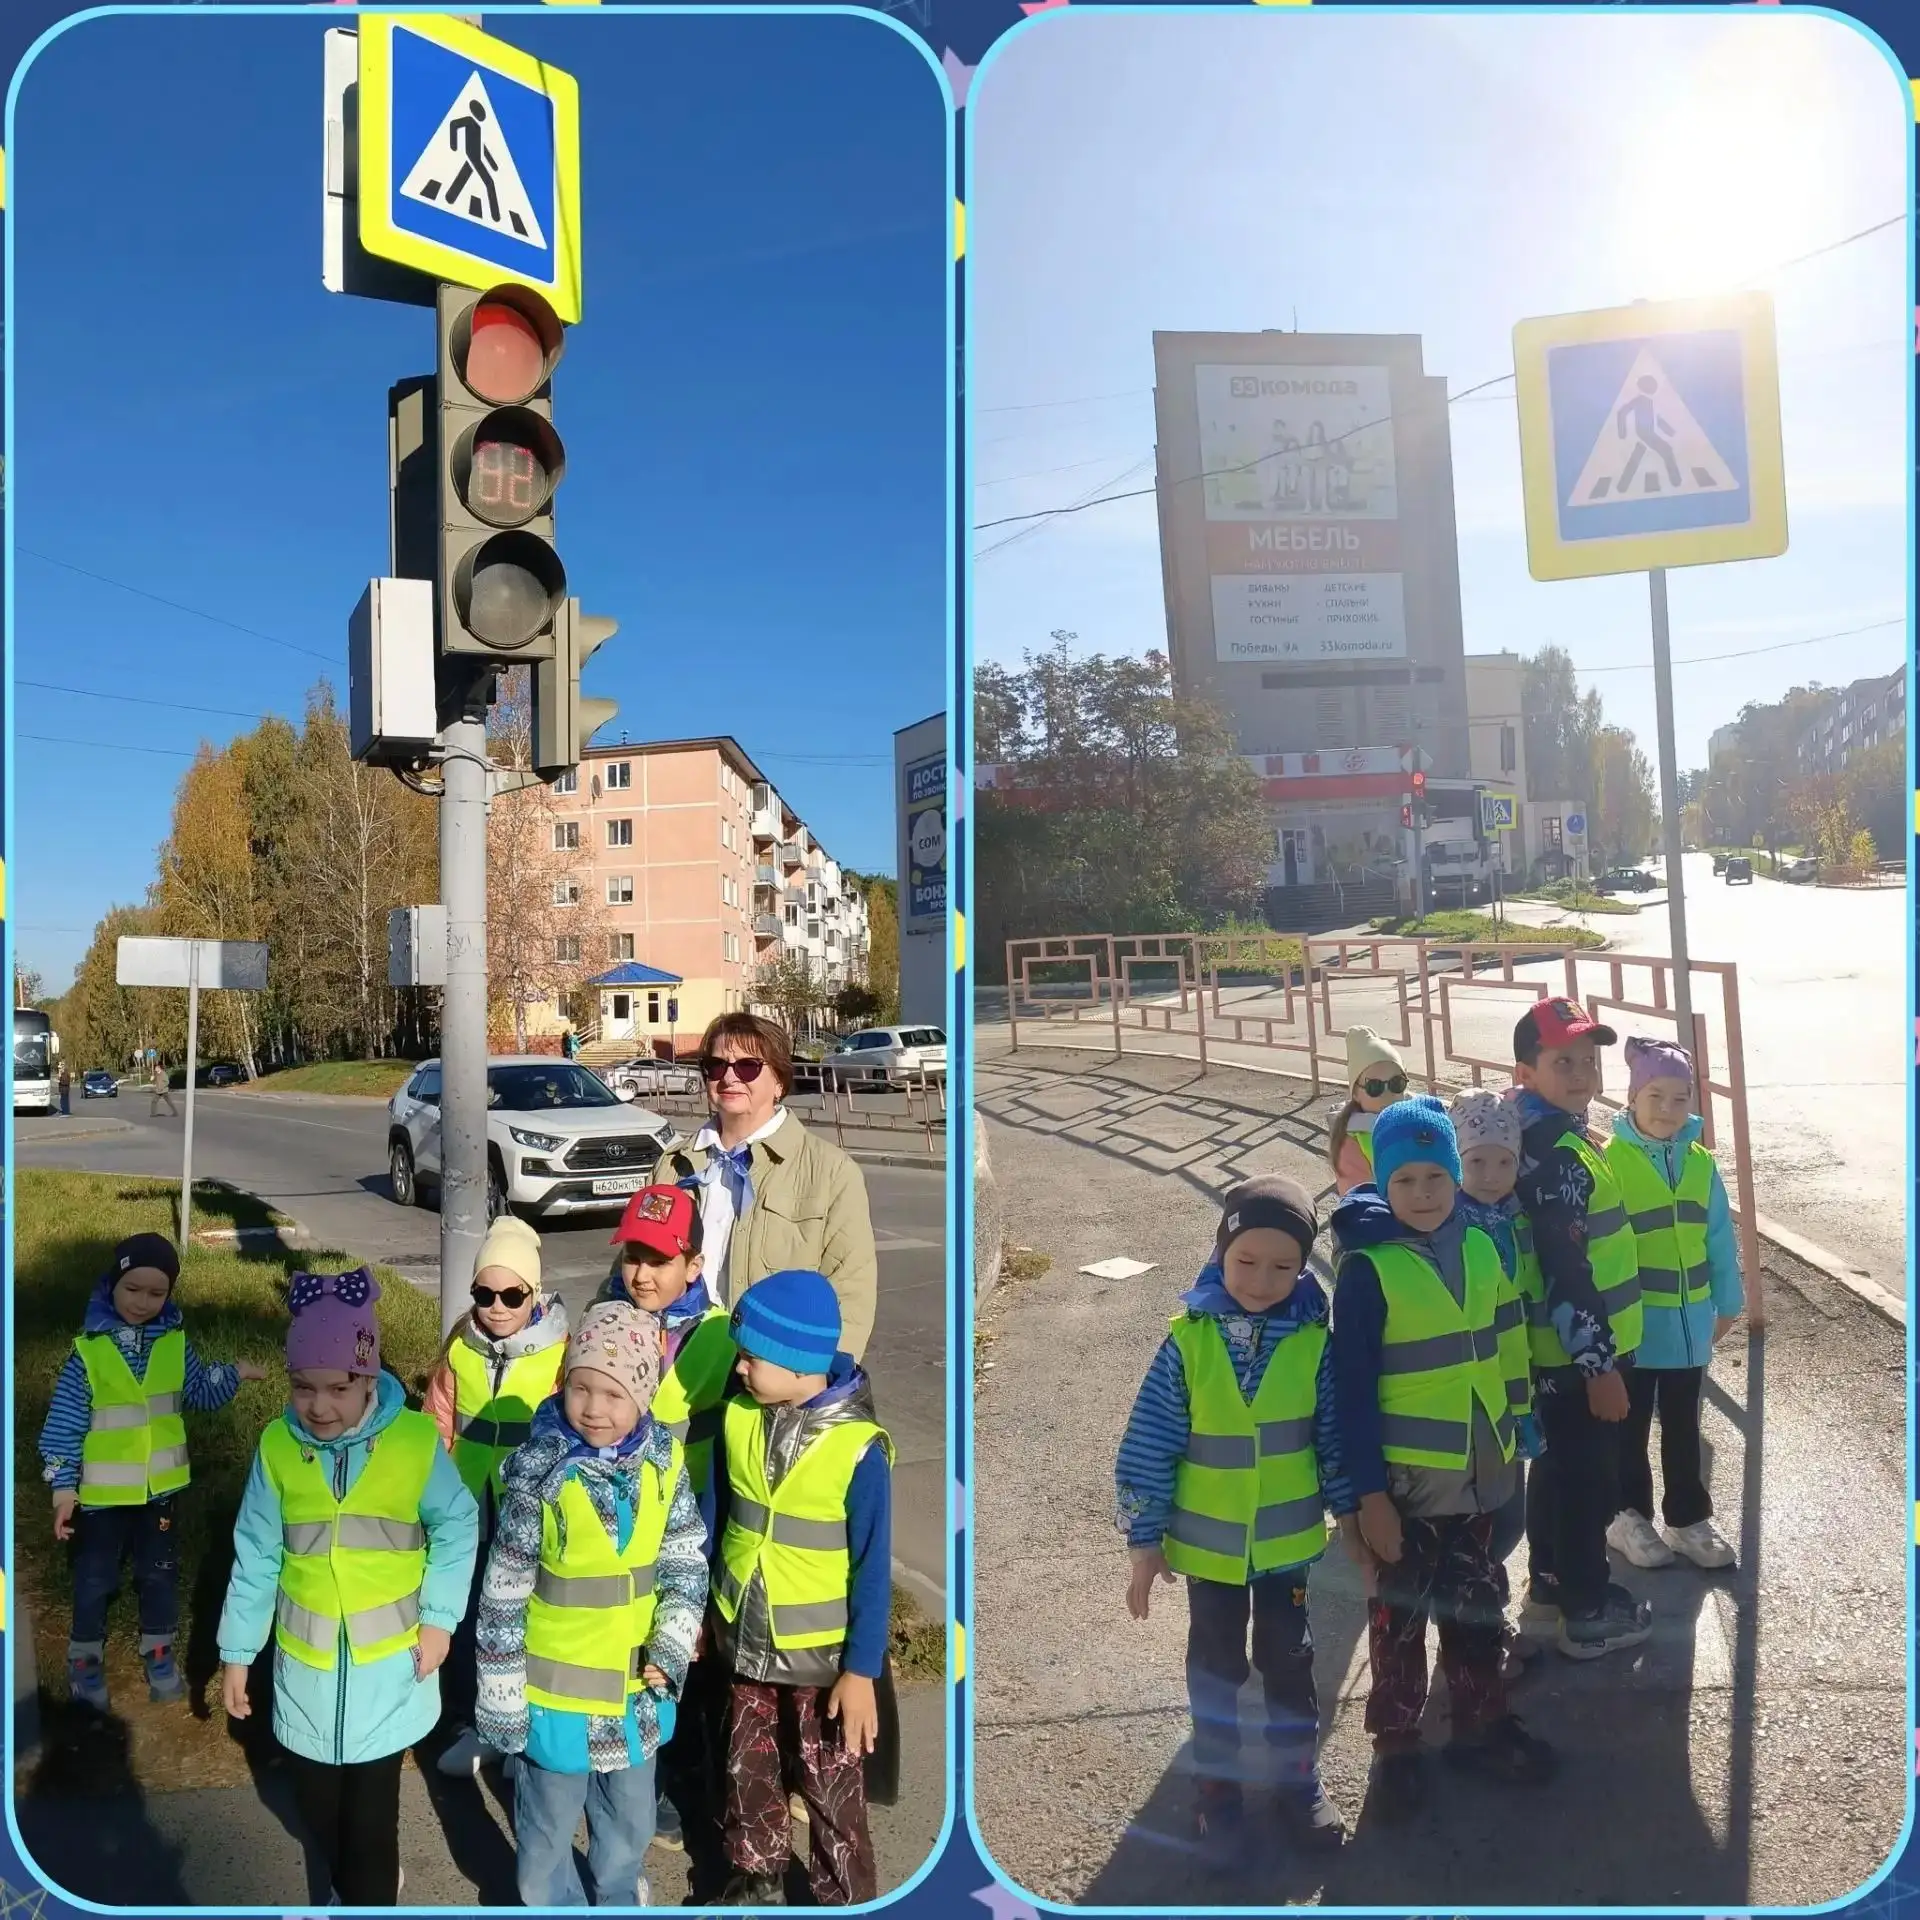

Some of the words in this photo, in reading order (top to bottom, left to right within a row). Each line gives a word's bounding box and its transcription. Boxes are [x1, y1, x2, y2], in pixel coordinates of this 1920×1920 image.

[1249, 525, 1360, 551] МЕБЕЛЬ
[913, 763, 946, 791] ДОСТ
[916, 884, 946, 903] БОНУ
